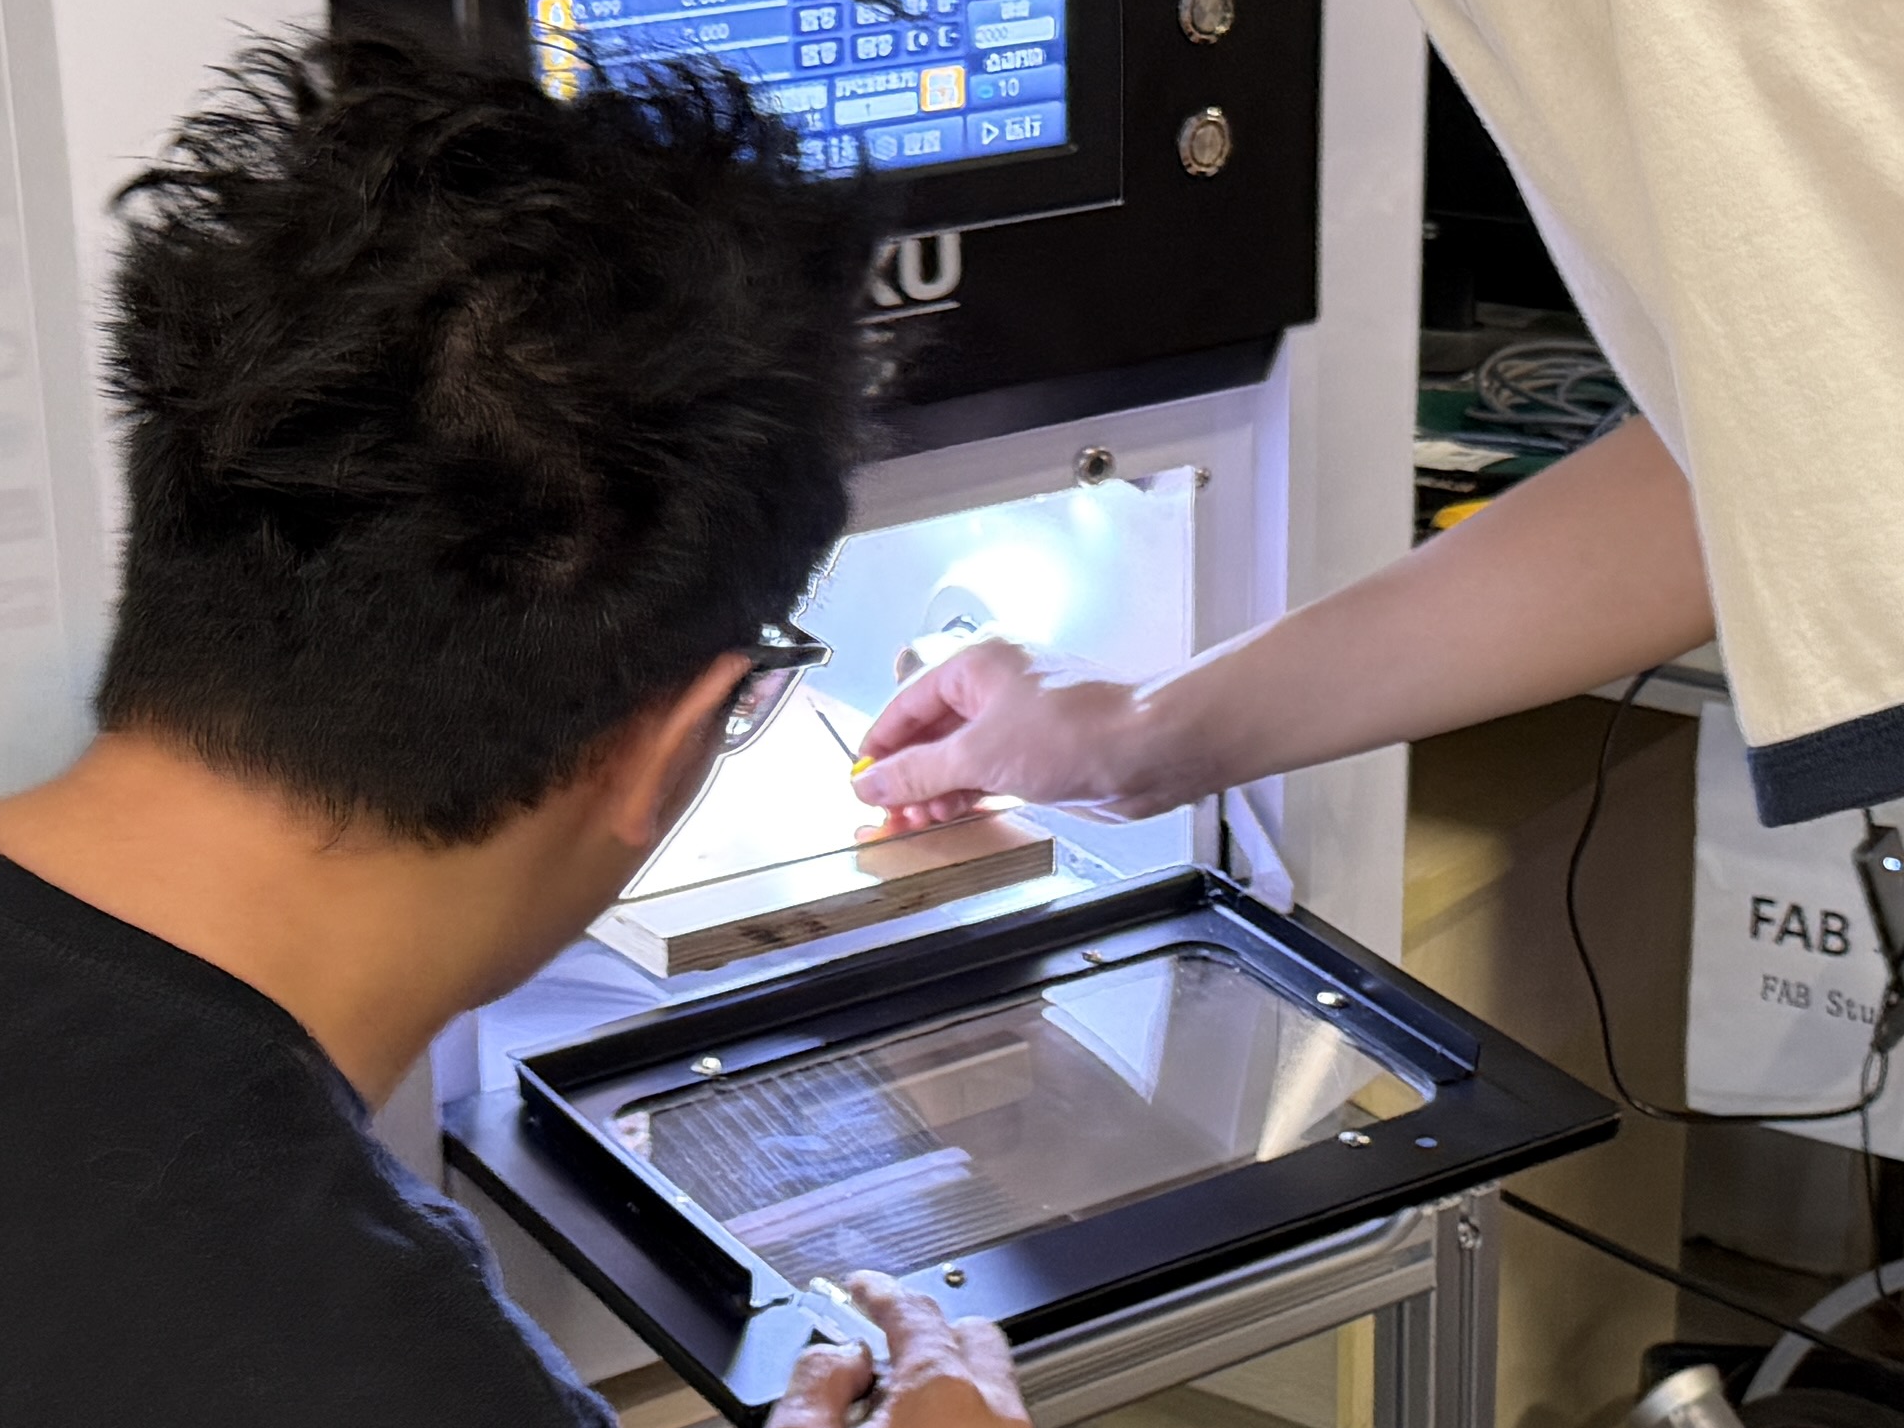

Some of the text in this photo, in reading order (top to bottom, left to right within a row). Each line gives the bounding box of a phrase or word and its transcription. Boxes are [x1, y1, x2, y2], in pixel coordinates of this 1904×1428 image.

[998, 77, 1020, 97] 10
[1748, 894, 1852, 958] FAB
[1760, 972, 1813, 1011] FAB
